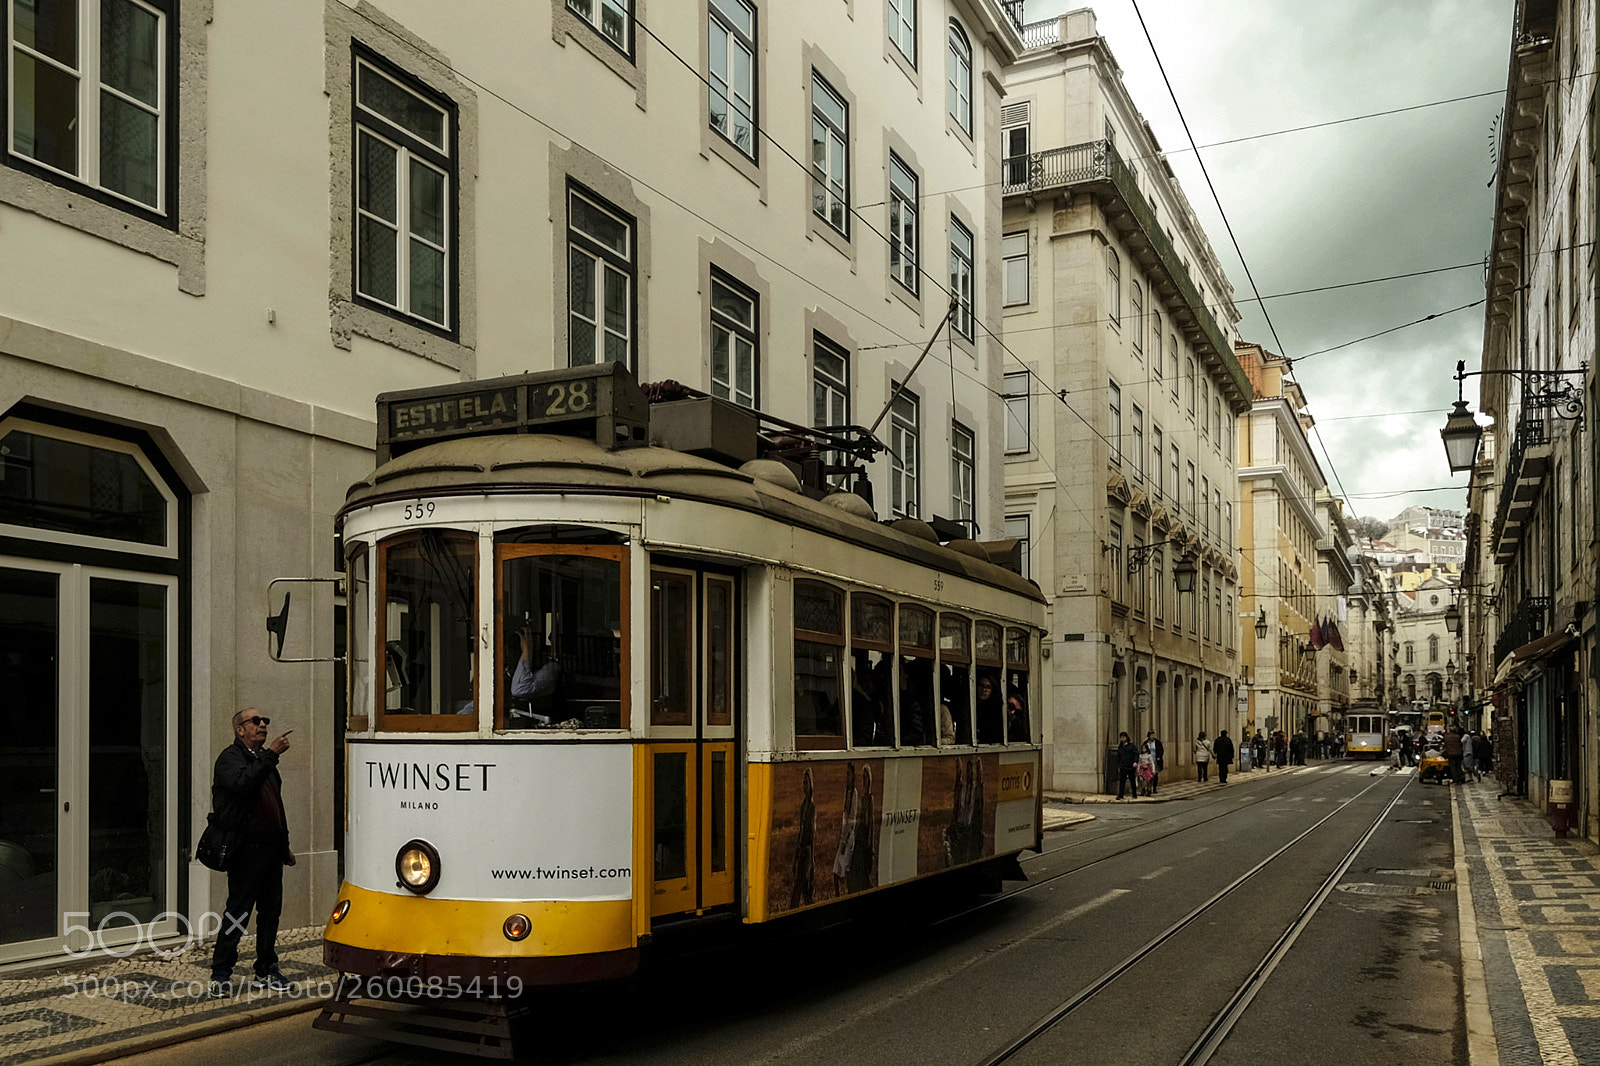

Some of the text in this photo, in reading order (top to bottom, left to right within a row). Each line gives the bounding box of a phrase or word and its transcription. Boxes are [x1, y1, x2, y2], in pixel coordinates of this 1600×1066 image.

[396, 381, 588, 428] ESTRELA 28
[404, 501, 436, 520] 559
[366, 761, 496, 792] TWINSET
[400, 801, 439, 810] MILANO
[886, 809, 917, 827] TWINSET
[491, 866, 632, 879] www.twinset.com
